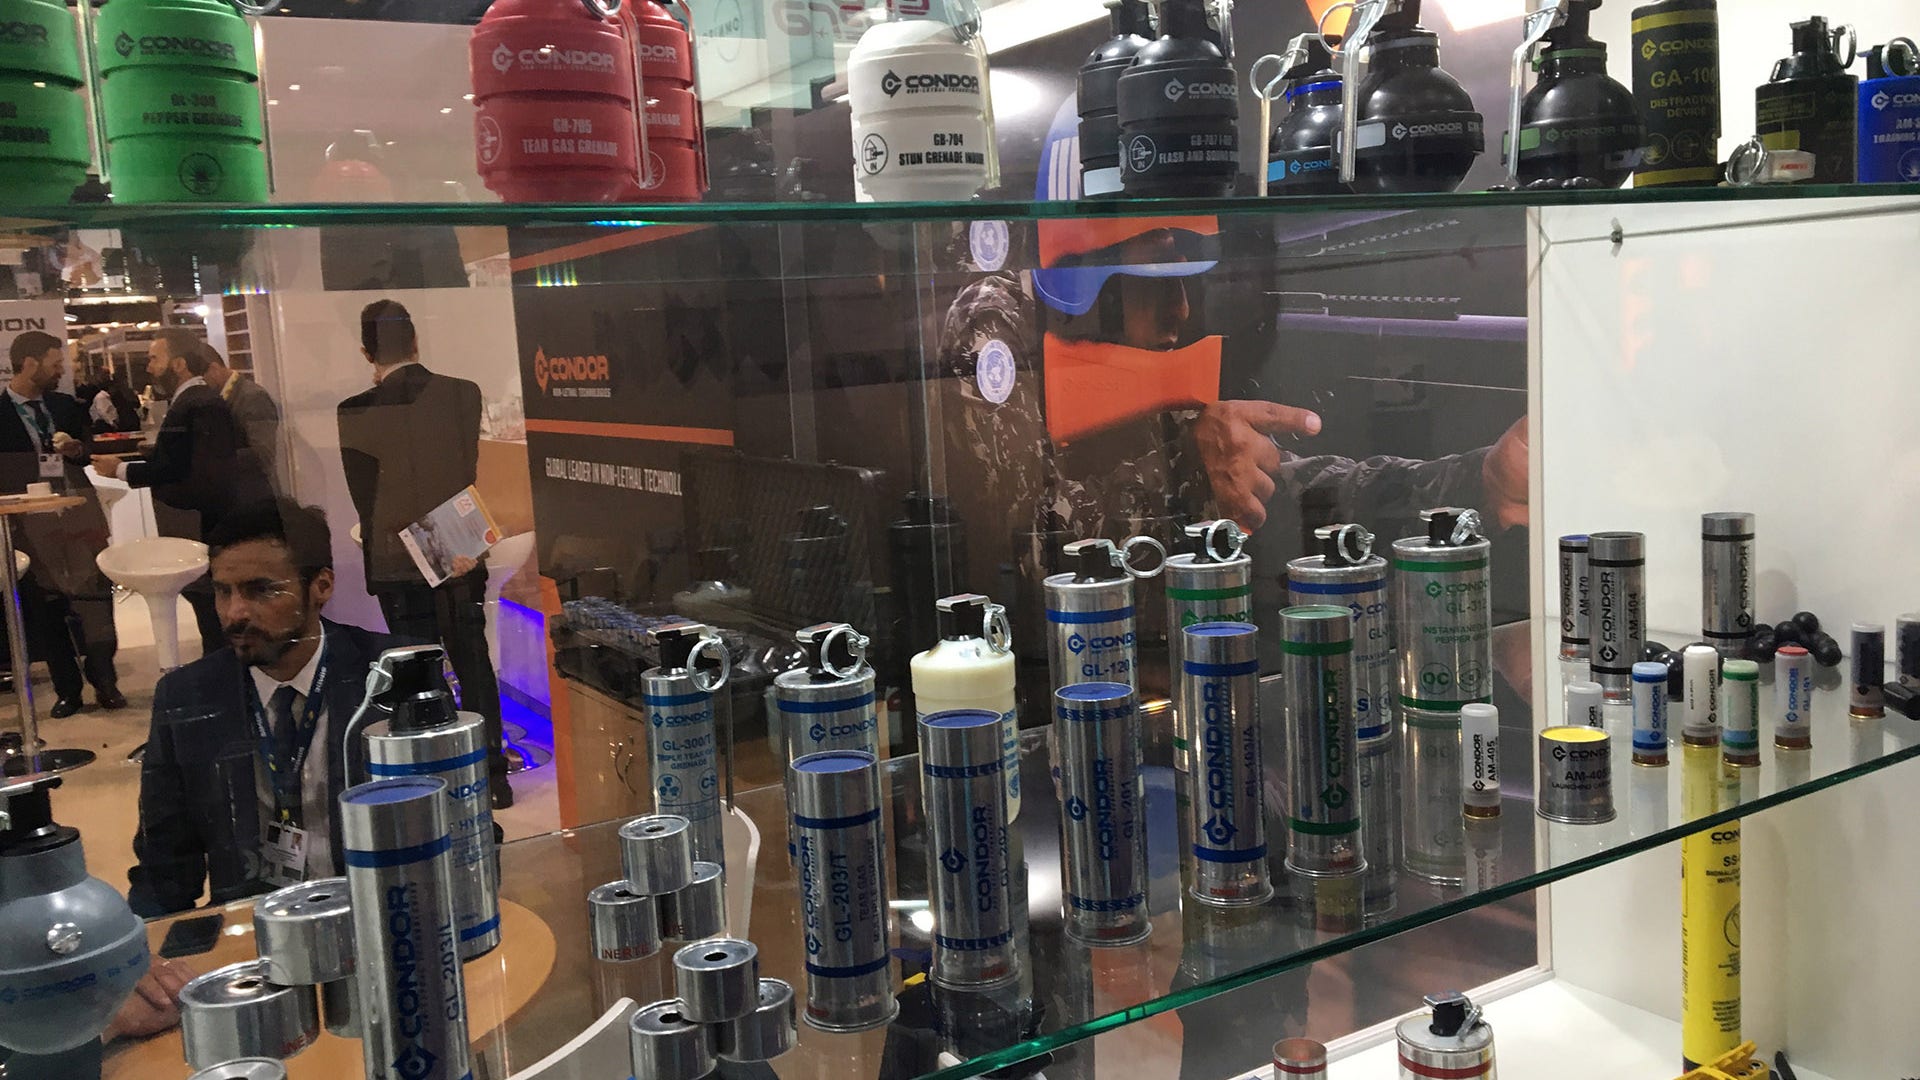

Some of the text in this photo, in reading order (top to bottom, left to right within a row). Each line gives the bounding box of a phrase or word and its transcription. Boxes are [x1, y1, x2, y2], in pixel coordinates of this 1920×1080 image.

[518, 49, 615, 67] CONDOR
[905, 74, 979, 90] CONDOR
[933, 133, 963, 146] GB-704
[1409, 121, 1463, 136] CONDOR
[522, 139, 618, 157] TEAR GAS GRENADE
[899, 152, 923, 166] STUN
[925, 151, 963, 165] GRENADE
[549, 355, 610, 381] CONDOR
[568, 459, 592, 482] LEADER
[600, 464, 643, 491] NON-LETHAL
[1562, 556, 1571, 616] CONDOR
[1601, 571, 1612, 643] CONDOR
[1422, 671, 1449, 686] OC
[1709, 669, 1717, 712] CONDOR
[1323, 669, 1342, 779] CONDOR
[1203, 682, 1226, 810] CONDOR
[1487, 740, 1497, 782] AM-405
[701, 774, 716, 789] CS
[972, 806, 993, 912] CONDOR
[801, 835, 815, 929] CONDOR
[829, 851, 853, 943] GL-203/T
[387, 885, 423, 1039] CONDOR
